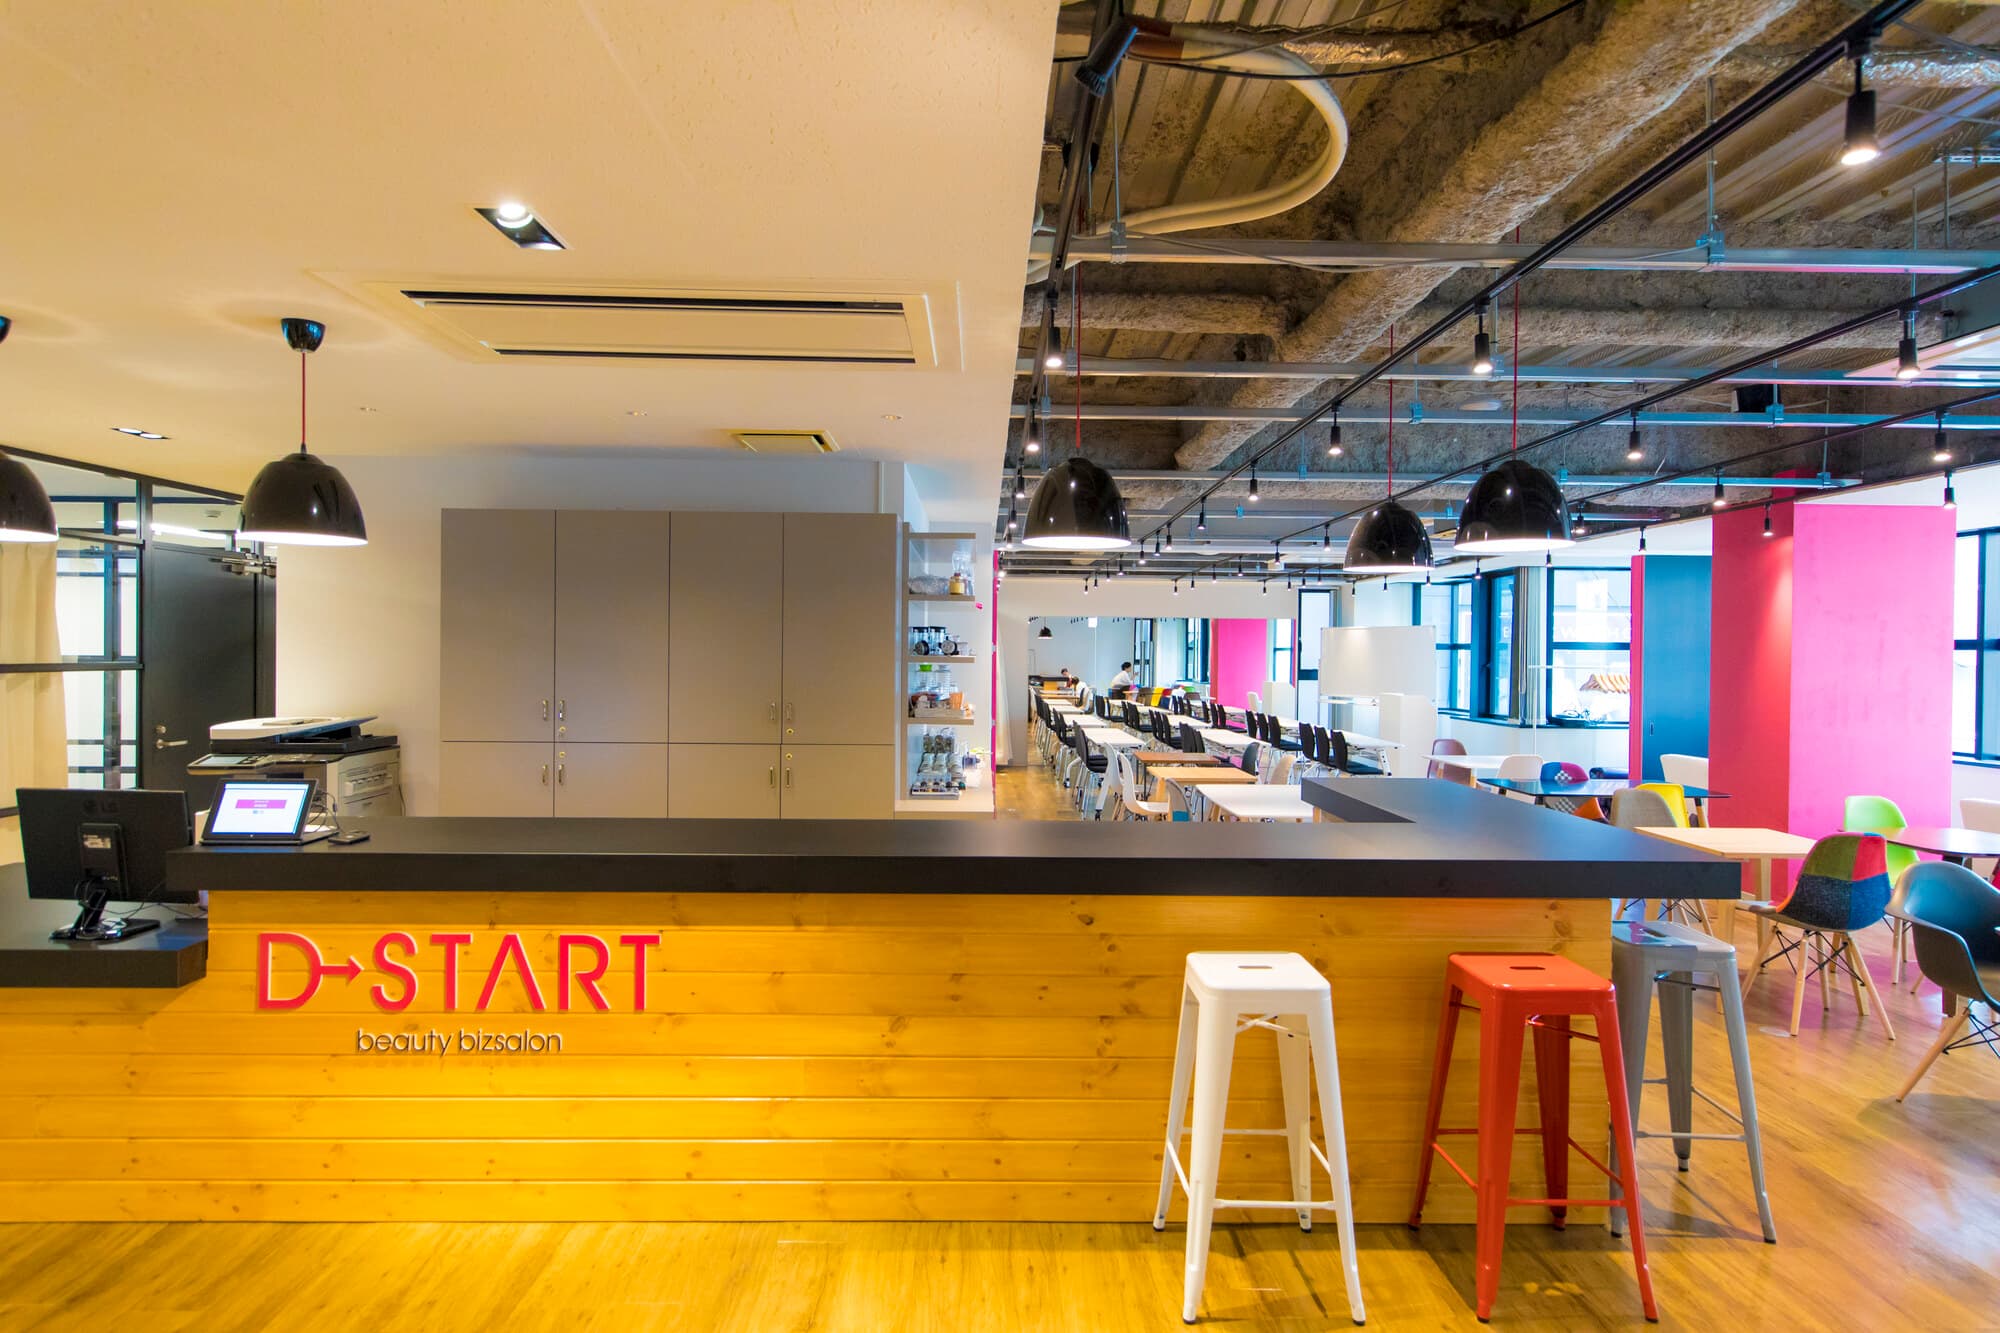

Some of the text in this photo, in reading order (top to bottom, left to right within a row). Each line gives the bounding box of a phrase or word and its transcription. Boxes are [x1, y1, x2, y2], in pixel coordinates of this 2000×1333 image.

[101, 800, 119, 813] LG
[357, 1029, 562, 1057] beauty bizsalon
